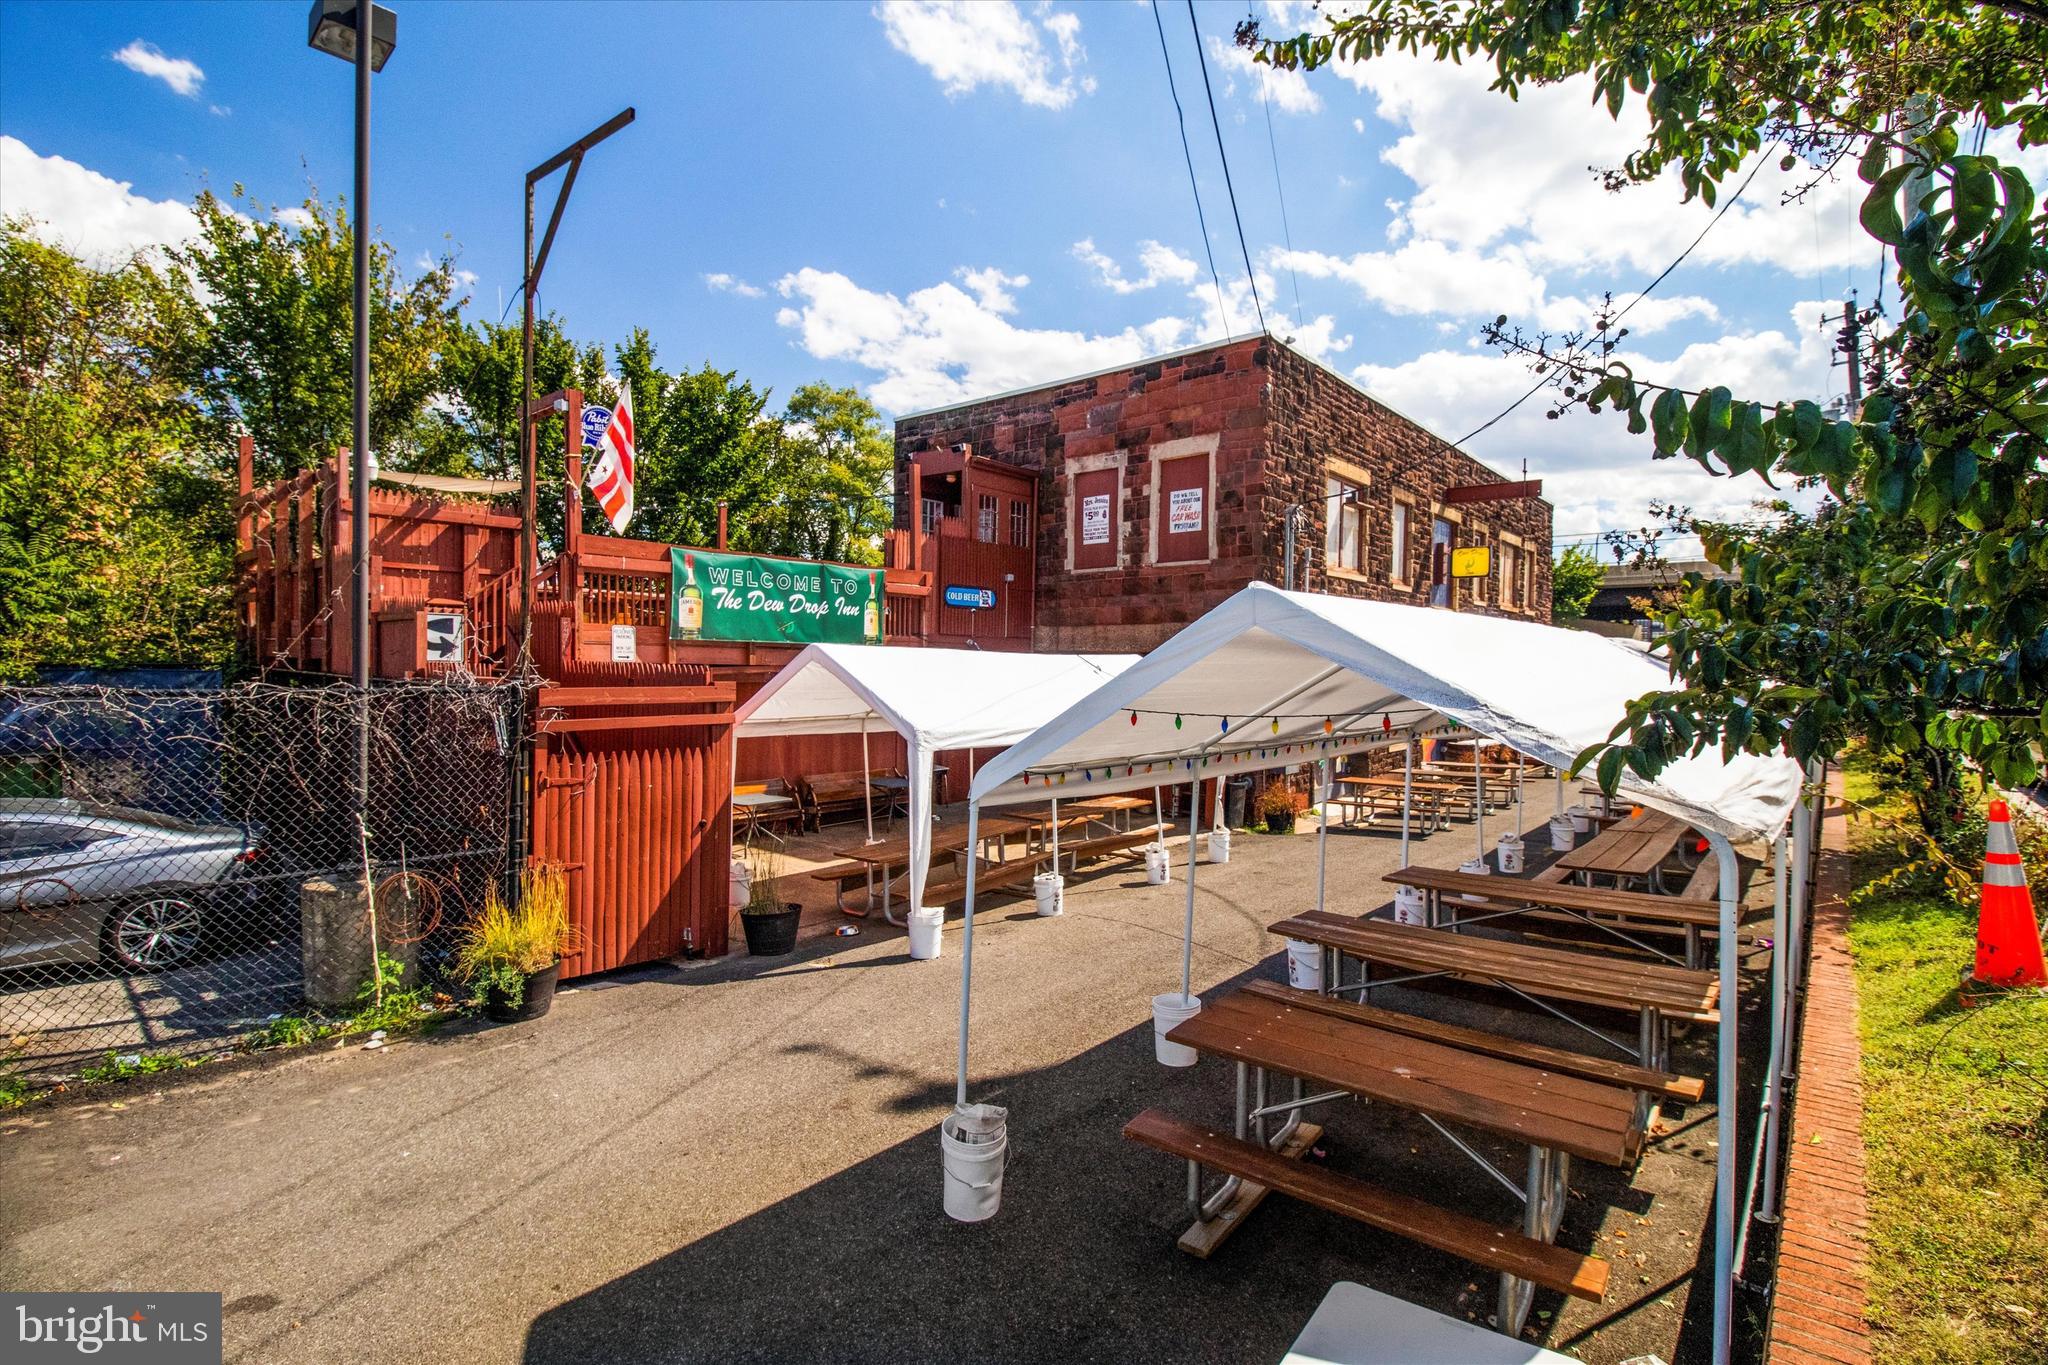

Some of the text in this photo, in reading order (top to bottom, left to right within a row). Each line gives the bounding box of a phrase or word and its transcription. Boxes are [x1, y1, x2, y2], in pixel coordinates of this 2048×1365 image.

[587, 411, 609, 424] Pabst
[1172, 511, 1200, 522] CAR WASH
[708, 566, 858, 595] WELCOME TO
[711, 587, 860, 619] The Dew Drop Inn
[947, 592, 962, 600] COLD
[964, 593, 980, 602] BEER
